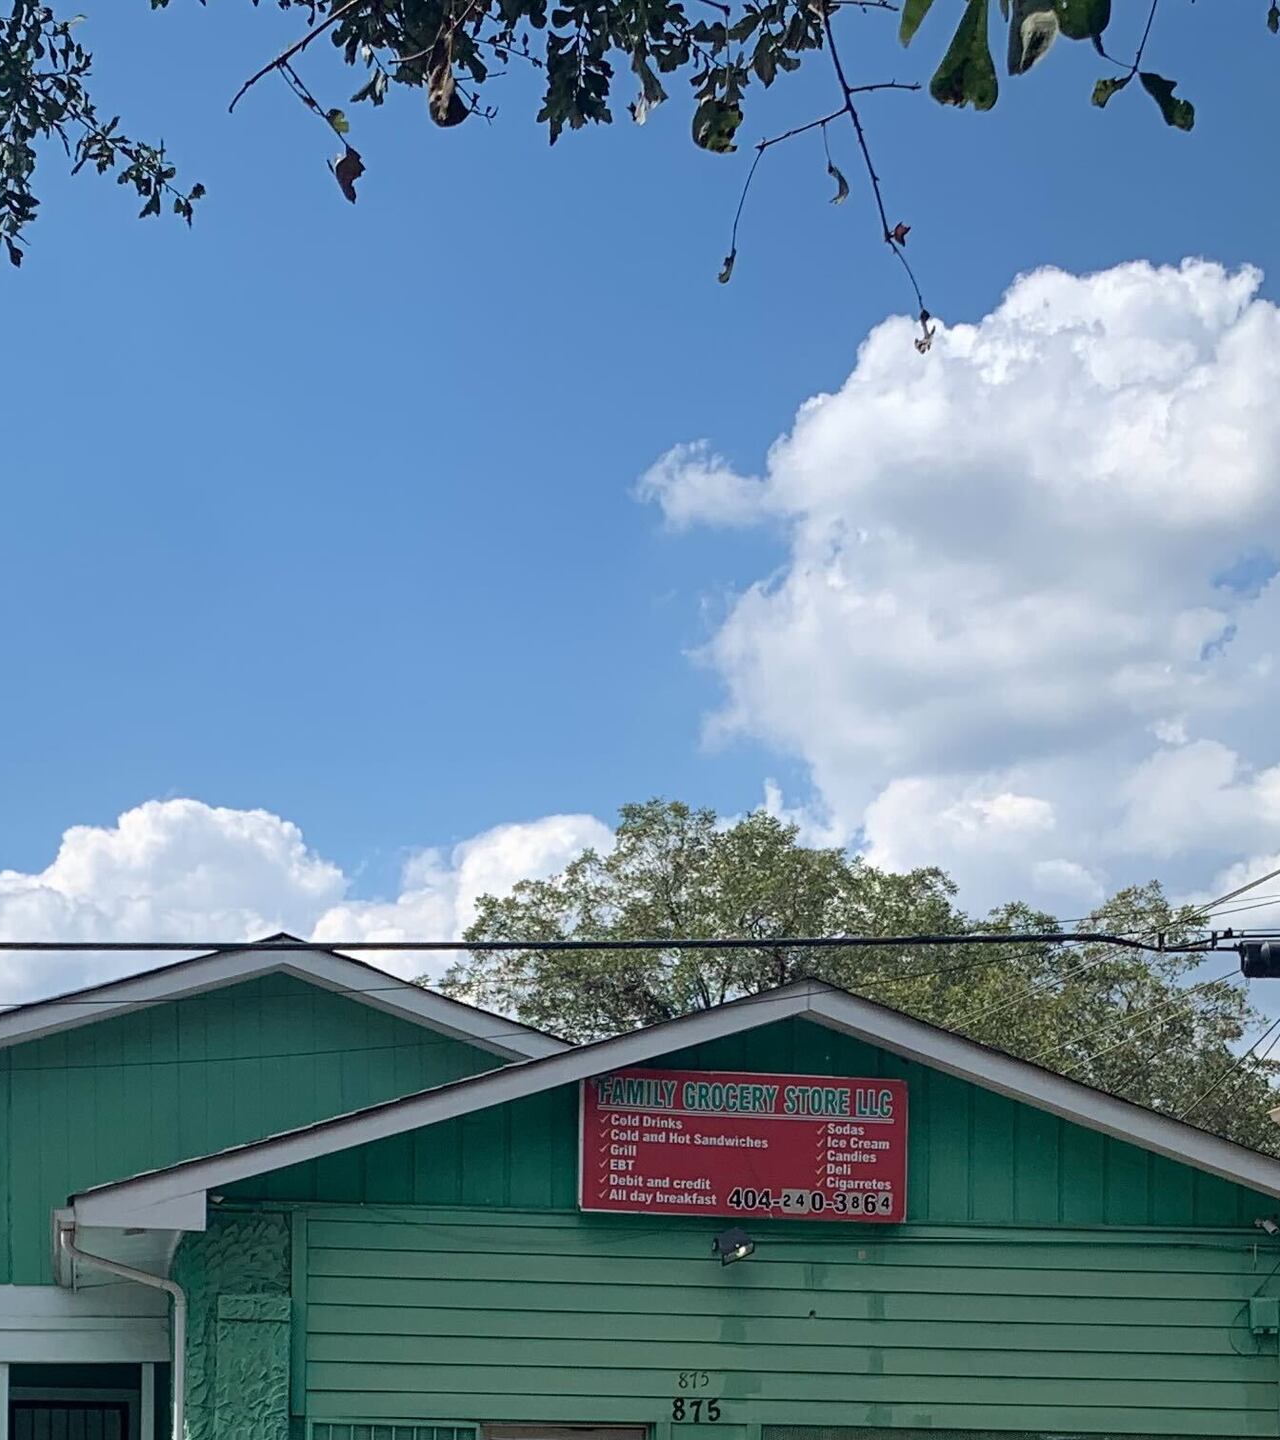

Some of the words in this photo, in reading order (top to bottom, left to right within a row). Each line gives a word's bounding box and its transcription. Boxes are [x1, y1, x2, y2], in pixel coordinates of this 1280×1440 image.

[598, 1076, 677, 1108] FAMILY
[683, 1082, 779, 1113] GROCERY
[784, 1086, 850, 1116] STORE
[856, 1089, 893, 1117] LLC
[611, 1114, 639, 1126] Cold
[643, 1117, 682, 1129] Drinks
[827, 1124, 865, 1135] Sodas
[611, 1129, 639, 1141] Cold
[643, 1131, 665, 1142] and
[669, 1133, 691, 1145] Hot
[694, 1134, 768, 1148] Sandwiches
[827, 1137, 847, 1148] Ice
[850, 1137, 890, 1150] Cream
[610, 1144, 637, 1156] Grill
[827, 1150, 877, 1163] Candies
[610, 1159, 635, 1171] EBT
[826, 1164, 851, 1175] Deli
[609, 1174, 643, 1187] Debit
[646, 1176, 669, 1188] and
[673, 1178, 711, 1190] credit
[826, 1177, 892, 1191] Cigarretes
[609, 1189, 626, 1201] All
[630, 1190, 653, 1205] day
[656, 1192, 717, 1205] breakfast
[727, 1187, 892, 1214] 404-240-3864
[678, 1371, 709, 1389] 875
[672, 1397, 721, 1423] 875
